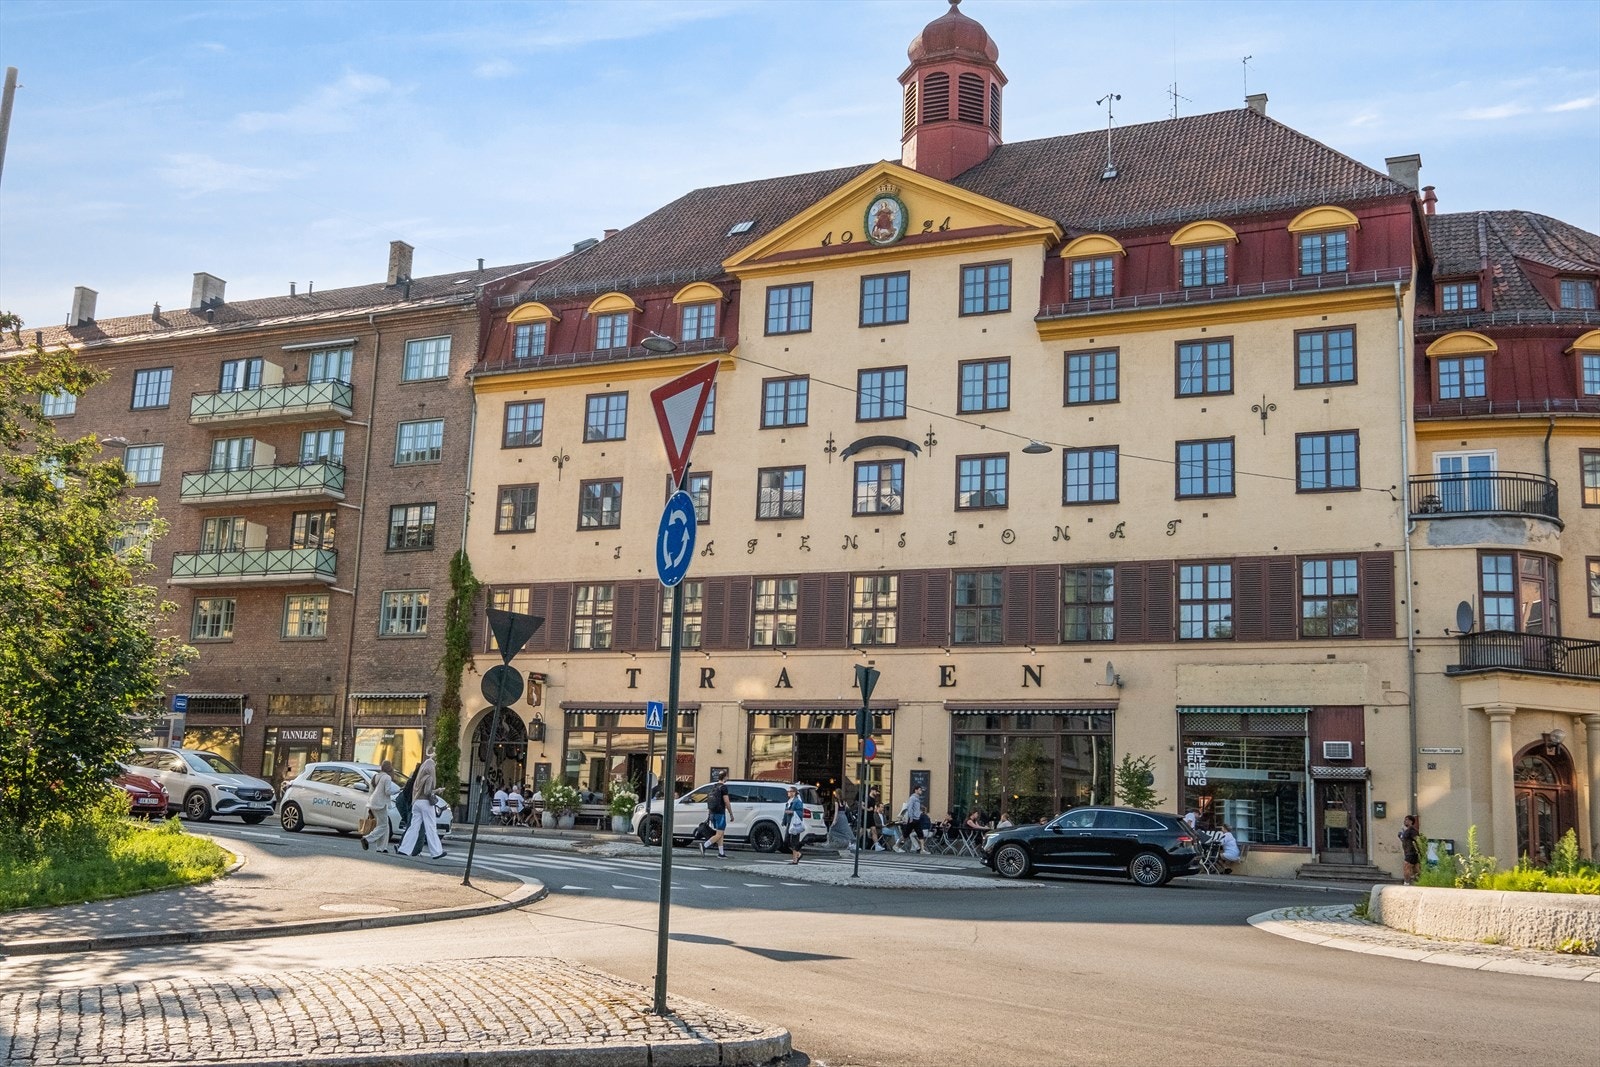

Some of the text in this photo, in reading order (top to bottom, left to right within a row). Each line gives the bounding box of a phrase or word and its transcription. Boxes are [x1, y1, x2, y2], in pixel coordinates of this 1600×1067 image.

[281, 730, 318, 740] TANNLEGE
[1186, 747, 1208, 755] GET
[1187, 778, 1207, 786] ING
[312, 797, 356, 810] park nordic
